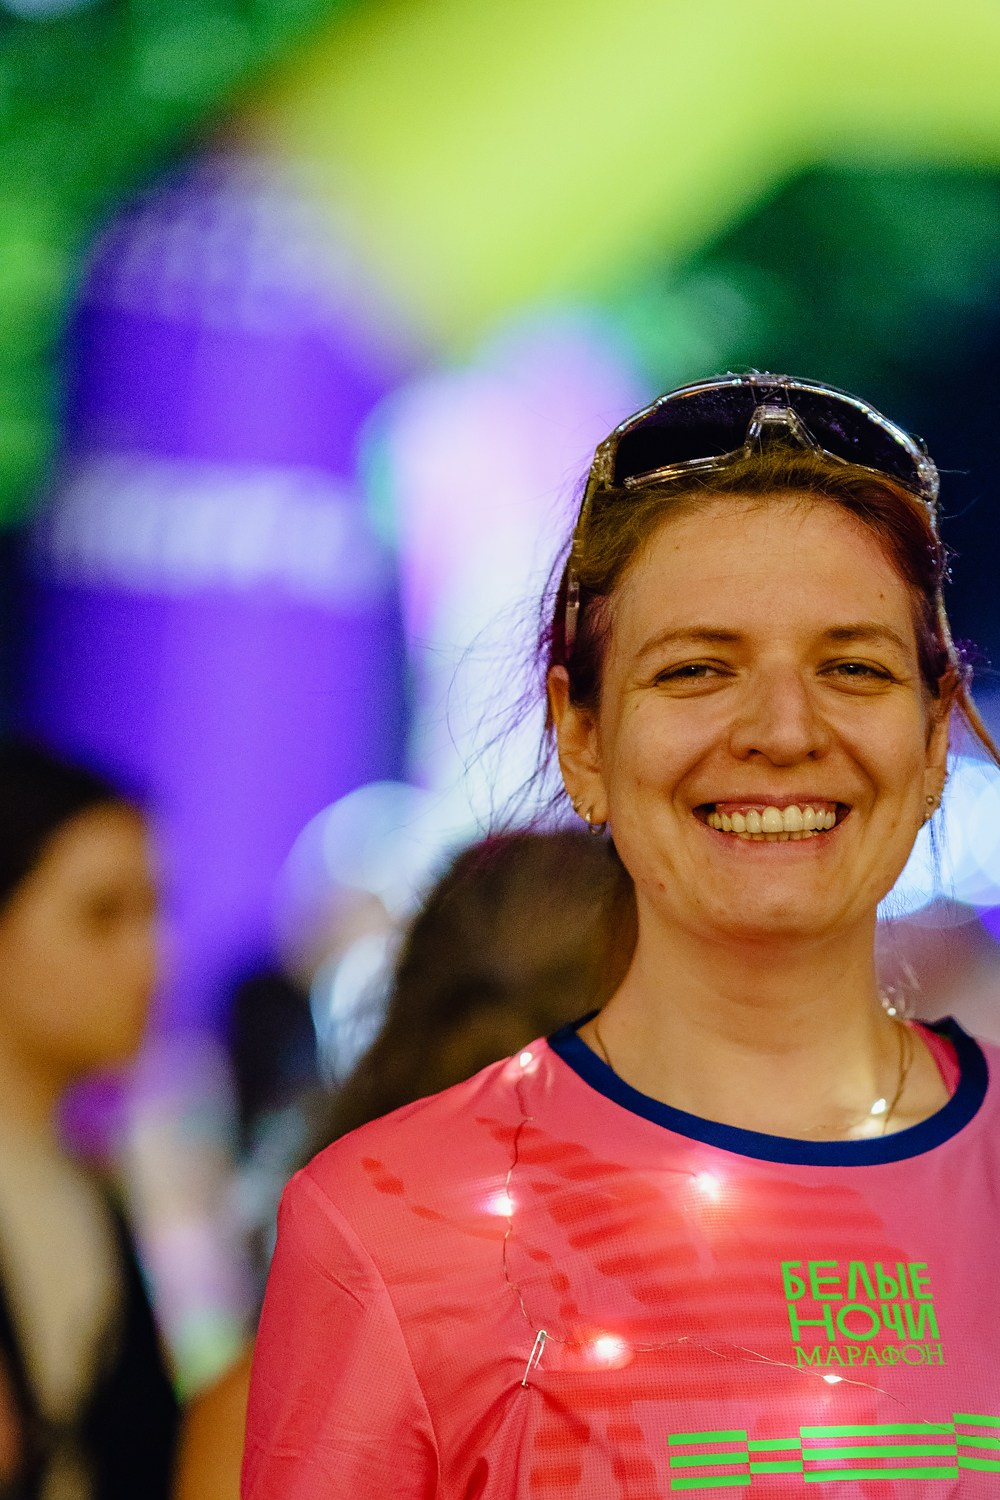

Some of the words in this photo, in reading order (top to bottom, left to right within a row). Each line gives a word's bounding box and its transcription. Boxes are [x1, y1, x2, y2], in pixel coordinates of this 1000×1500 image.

[780, 1260, 933, 1301] БЕЛЫЕ
[787, 1303, 941, 1342] НОЧИ
[792, 1343, 947, 1368] МАРАФОН
